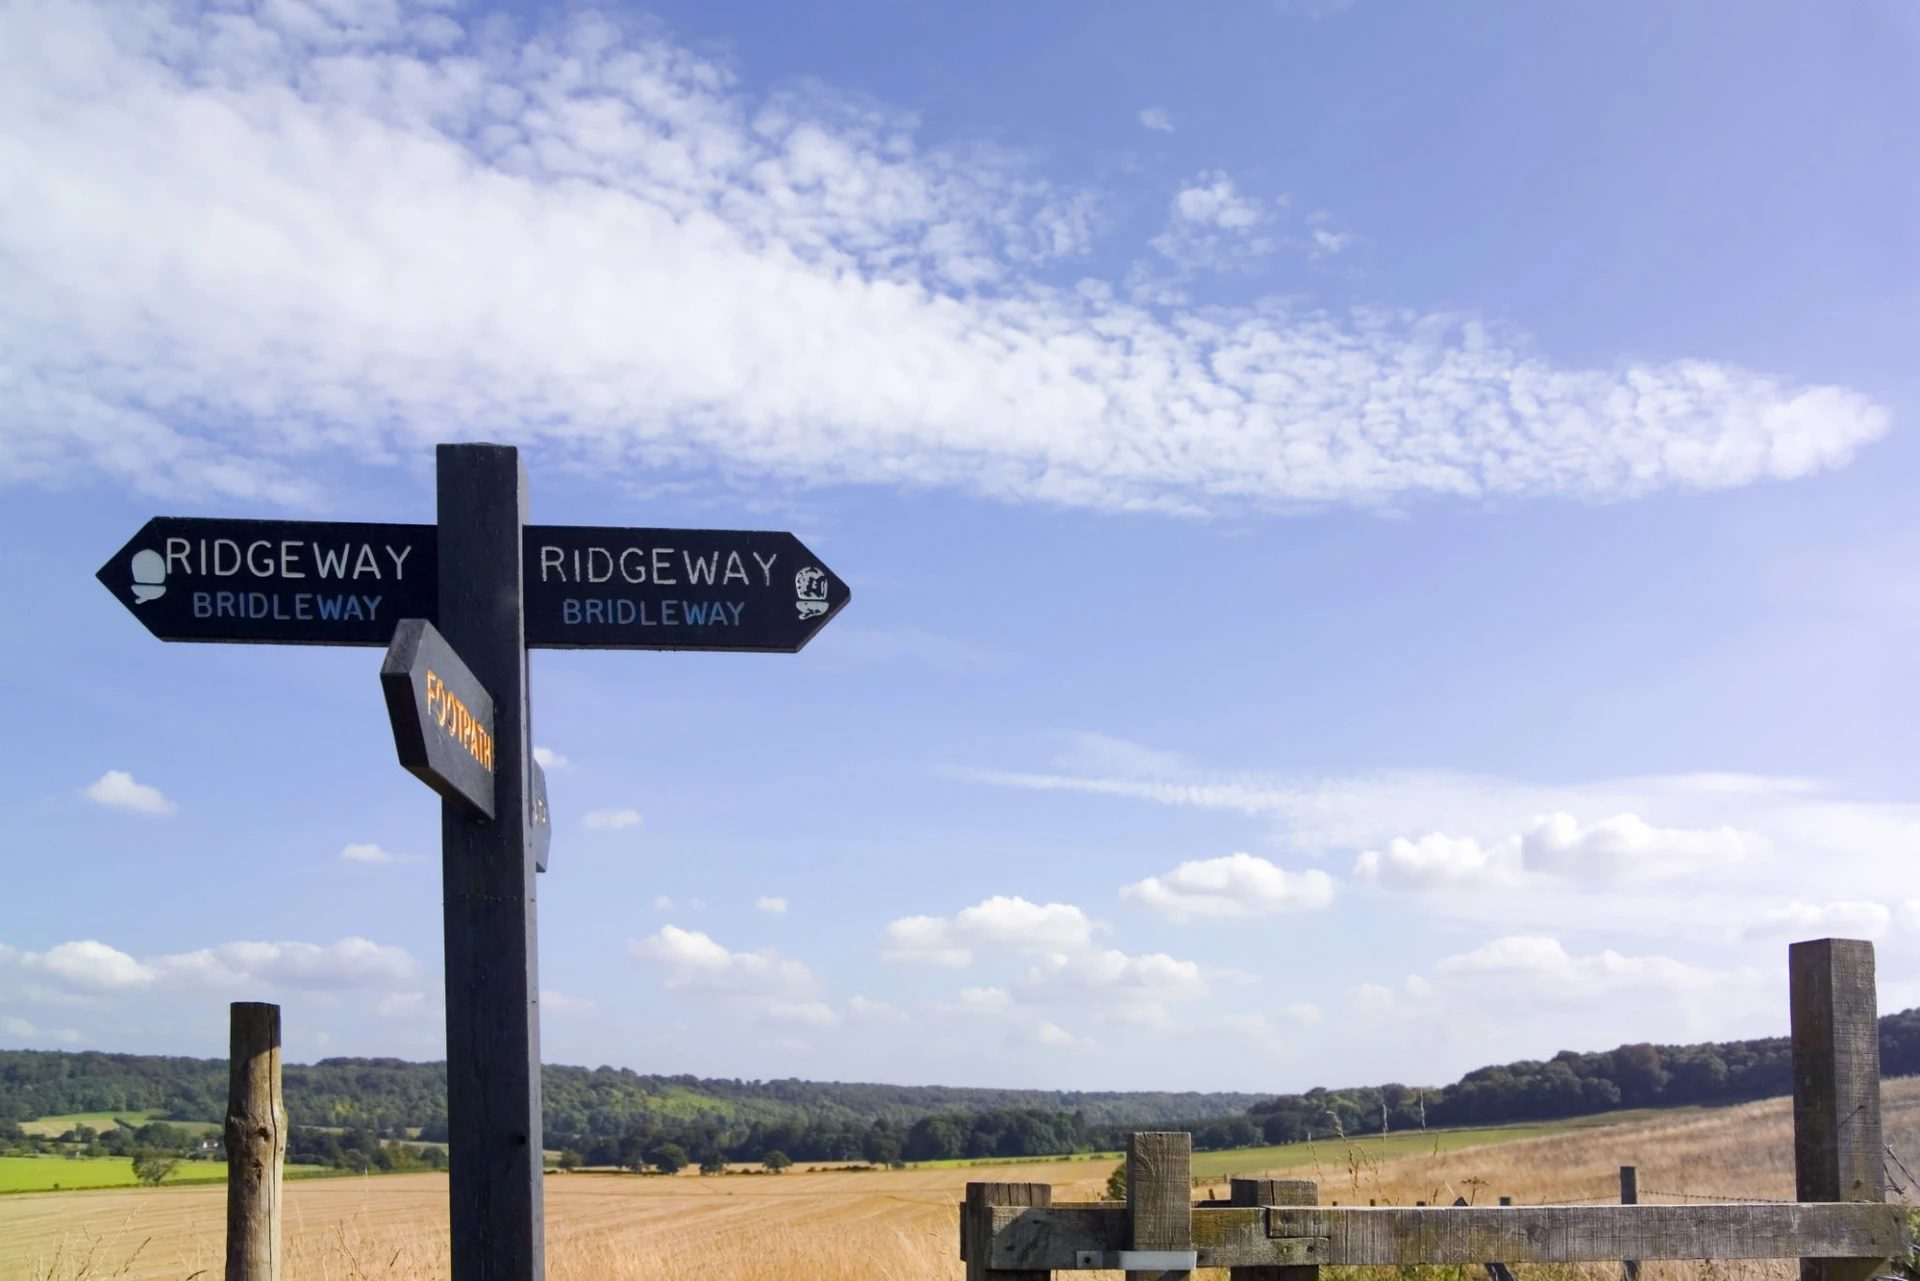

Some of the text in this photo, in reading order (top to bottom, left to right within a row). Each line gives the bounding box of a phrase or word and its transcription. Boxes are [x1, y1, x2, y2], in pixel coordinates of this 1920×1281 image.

[165, 537, 412, 580] RIDGEWAY
[541, 546, 777, 586] RIDGEWAY
[193, 591, 383, 621] BRIDLEWAY
[562, 598, 745, 626] BRIDLEWAY
[426, 670, 492, 772] FOOTPATH
